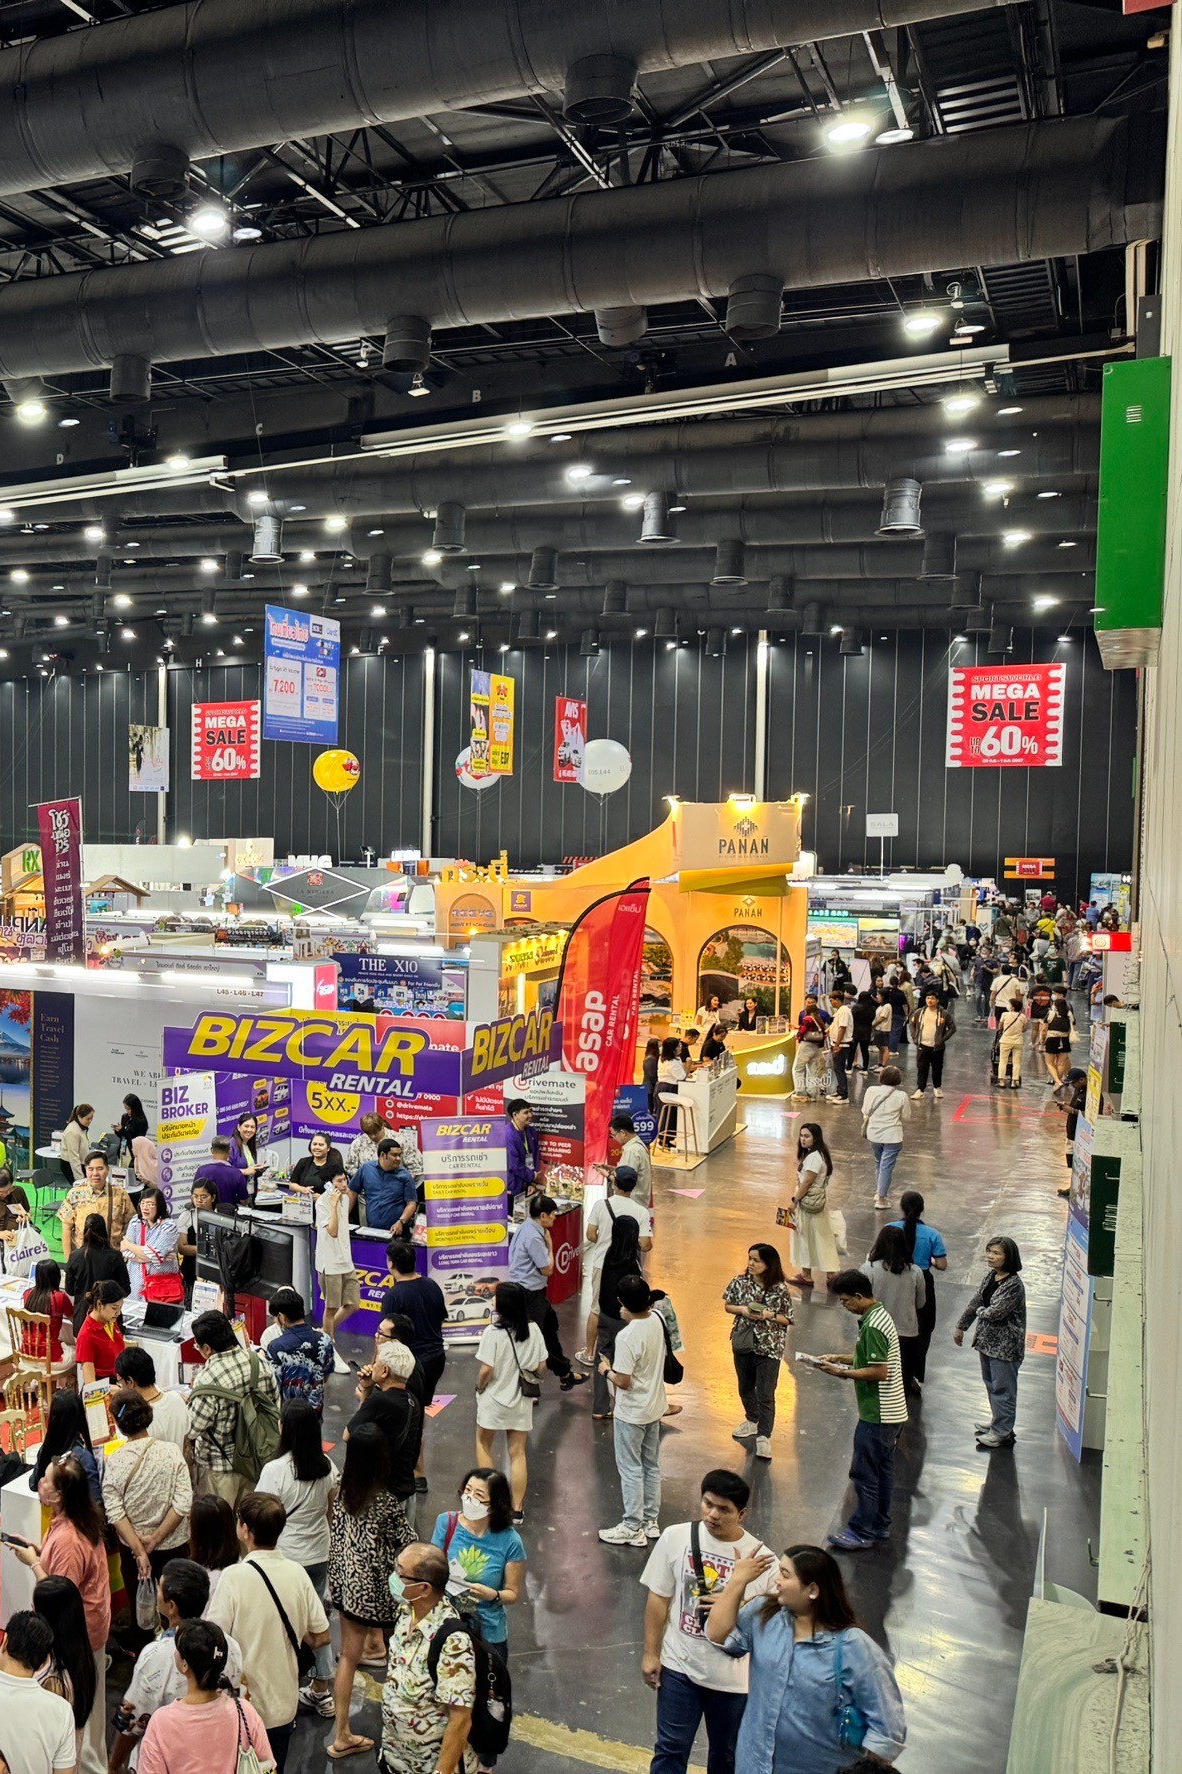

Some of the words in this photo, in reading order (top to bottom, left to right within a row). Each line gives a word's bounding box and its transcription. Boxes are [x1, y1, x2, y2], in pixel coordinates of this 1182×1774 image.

[971, 683, 1040, 700] MEGA
[971, 701, 1040, 721] SALE
[205, 715, 246, 728] MEGA
[206, 730, 246, 745] SALE
[980, 725, 1038, 756] 60%
[212, 748, 247, 771] 60%
[22, 850, 41, 872] RX
[733, 908, 762, 918] PANAN
[359, 958, 387, 972] THE
[41, 1014, 59, 1023] Earn
[609, 994, 620, 1028] RENTAL
[41, 1024, 64, 1033] Travel
[575, 990, 606, 1073] asap
[40, 1034, 59, 1043] Cash
[188, 1015, 426, 1076] BIZCAR
[471, 1010, 553, 1076] BIZCAR
[605, 1028, 614, 1047] CAR
[523, 1055, 550, 1078] RENTAL
[112, 1077, 142, 1086] TRAVEL
[329, 1073, 416, 1098] RENTAL
[162, 1086, 189, 1106] BIZ
[161, 1103, 209, 1120] BROKER
[397, 1102, 433, 1112] @drivemate
[436, 1123, 491, 1136] BIZCAR
[633, 1122, 654, 1132] 599
[441, 1153, 488, 1163] บริการรถเช่า
[10, 1242, 48, 1263] claire's
